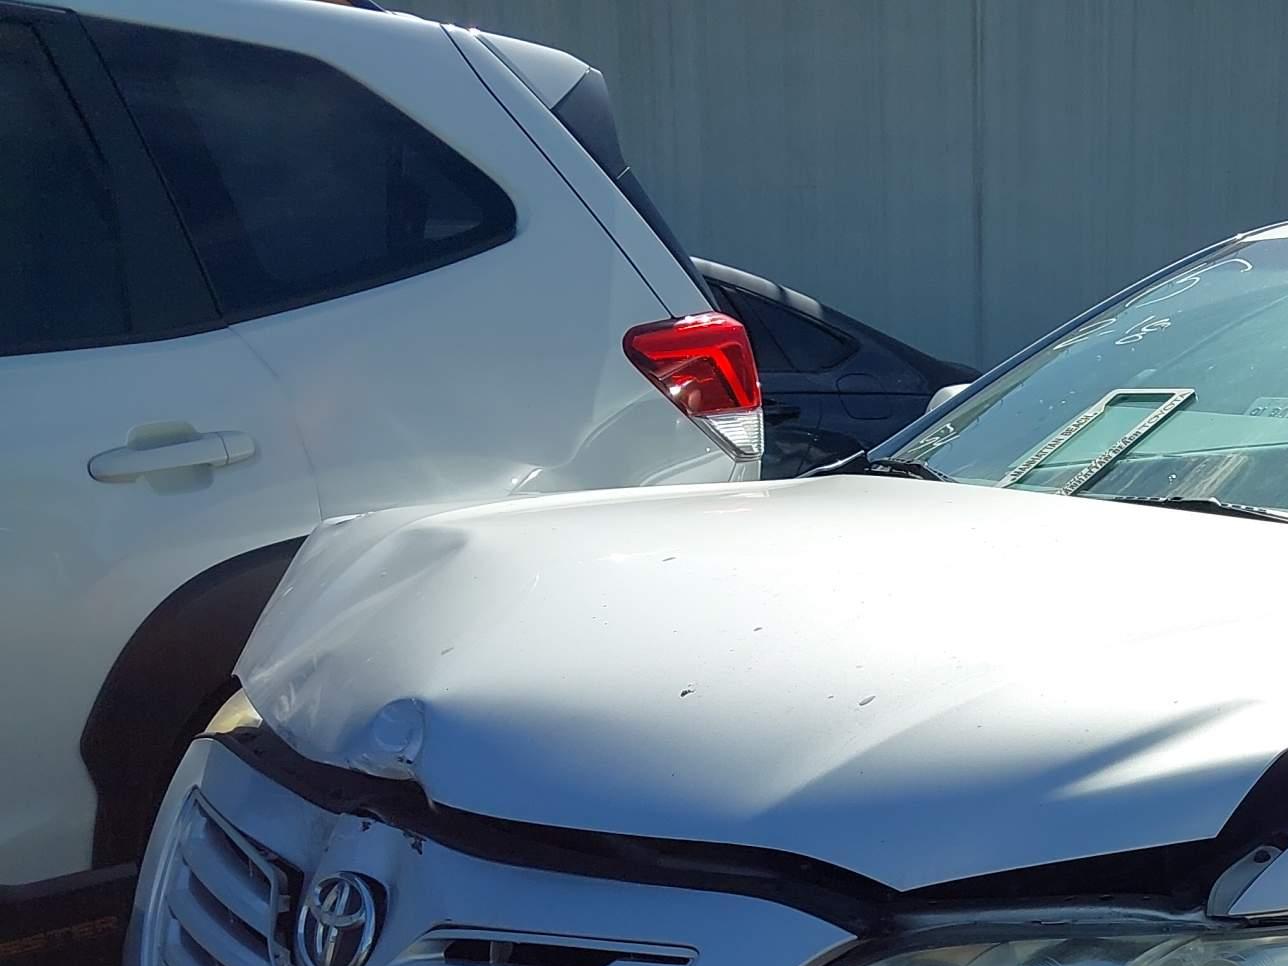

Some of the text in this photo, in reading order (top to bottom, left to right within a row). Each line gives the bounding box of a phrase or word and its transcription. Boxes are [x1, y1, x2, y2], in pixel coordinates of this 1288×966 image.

[1137, 392, 1188, 433] TOYOTA
[1010, 414, 1094, 478] MANHATTAN BEACH
